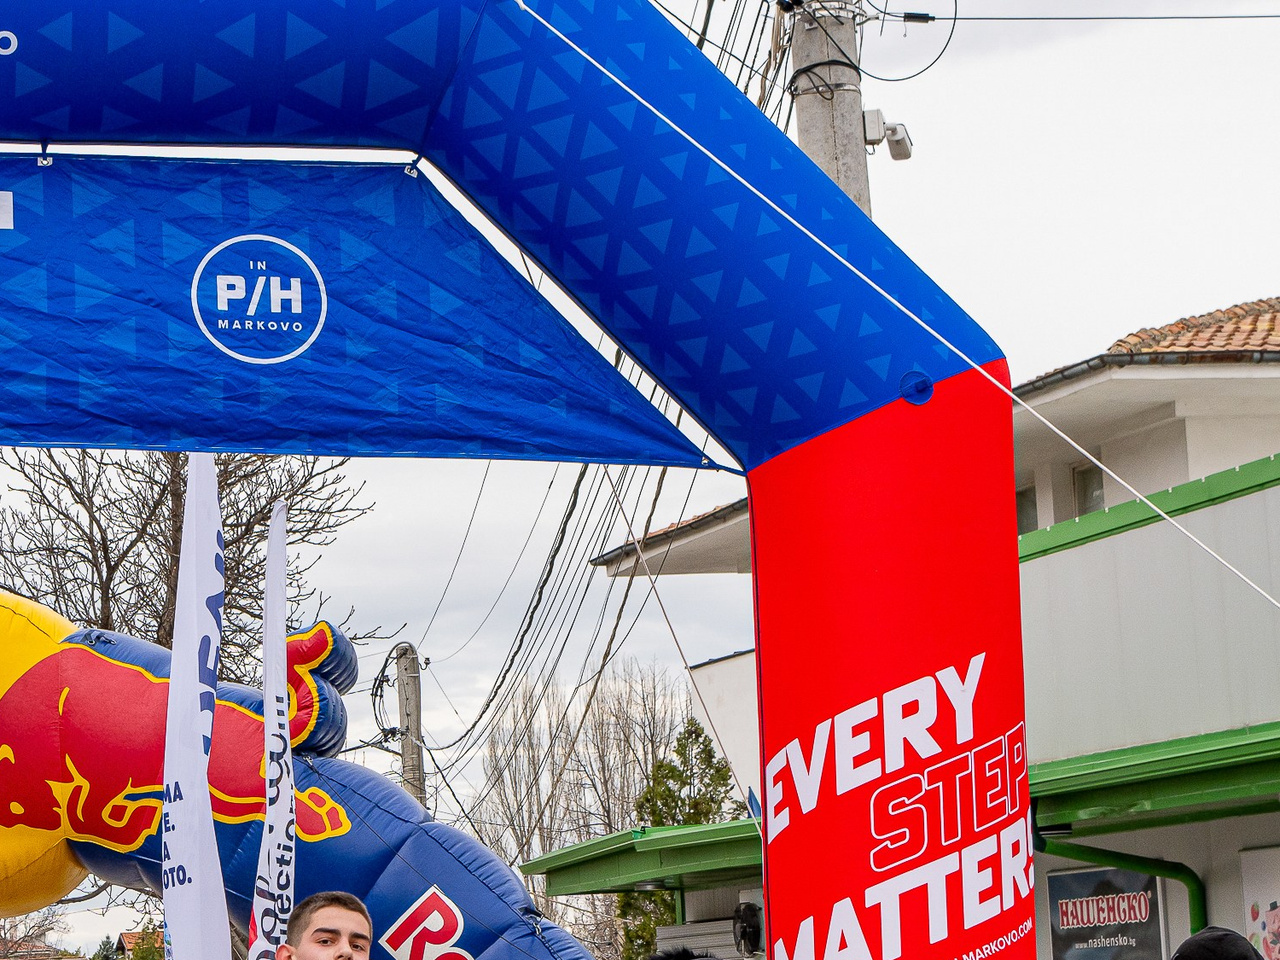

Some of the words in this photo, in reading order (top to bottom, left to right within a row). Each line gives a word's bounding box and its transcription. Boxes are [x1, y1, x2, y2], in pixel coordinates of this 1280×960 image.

[249, 260, 267, 271] IN
[216, 274, 303, 316] P/H
[218, 319, 303, 332] MARKOVO
[765, 651, 987, 846] EVERY
[869, 720, 1027, 873] STEP
[1059, 892, 1150, 928] НАШЕНСКО
[1075, 933, 1137, 950] www.nashensko.bg
